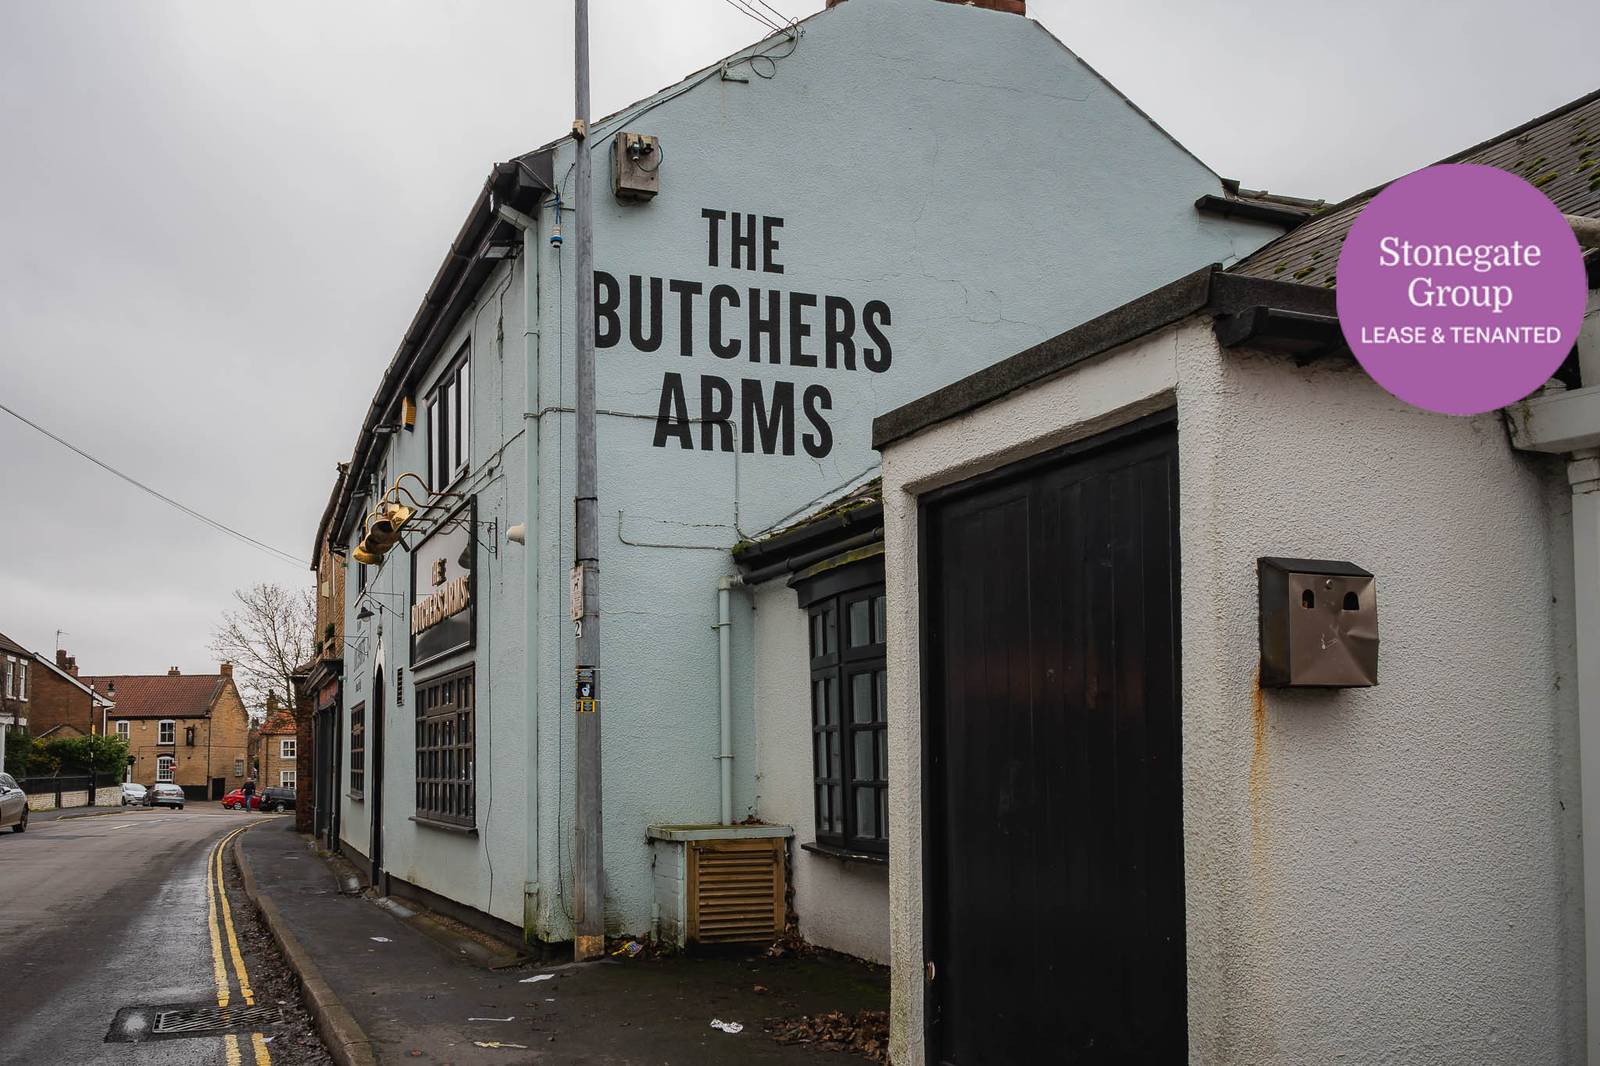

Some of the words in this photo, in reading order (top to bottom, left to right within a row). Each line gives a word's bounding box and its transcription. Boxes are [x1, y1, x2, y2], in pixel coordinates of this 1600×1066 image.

[701, 208, 784, 274] THE
[594, 271, 892, 373] BUTCHERS
[653, 372, 833, 458] ARMS
